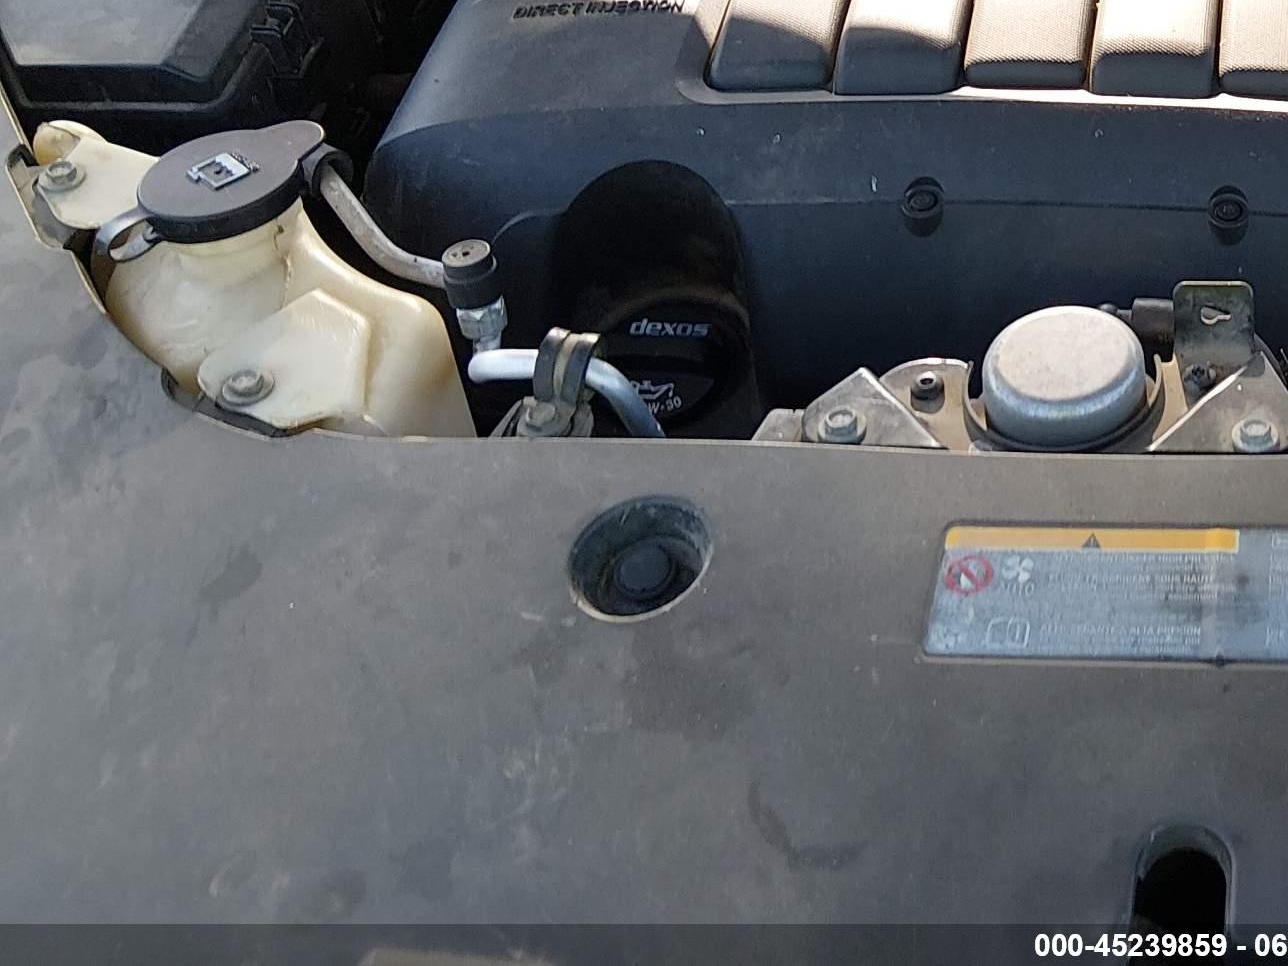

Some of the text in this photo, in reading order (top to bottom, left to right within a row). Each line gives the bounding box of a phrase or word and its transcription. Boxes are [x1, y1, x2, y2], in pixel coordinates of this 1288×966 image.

[513, 2, 583, 19] DIRECT
[629, 317, 713, 337] dexos
[647, 395, 682, 415] W-30
